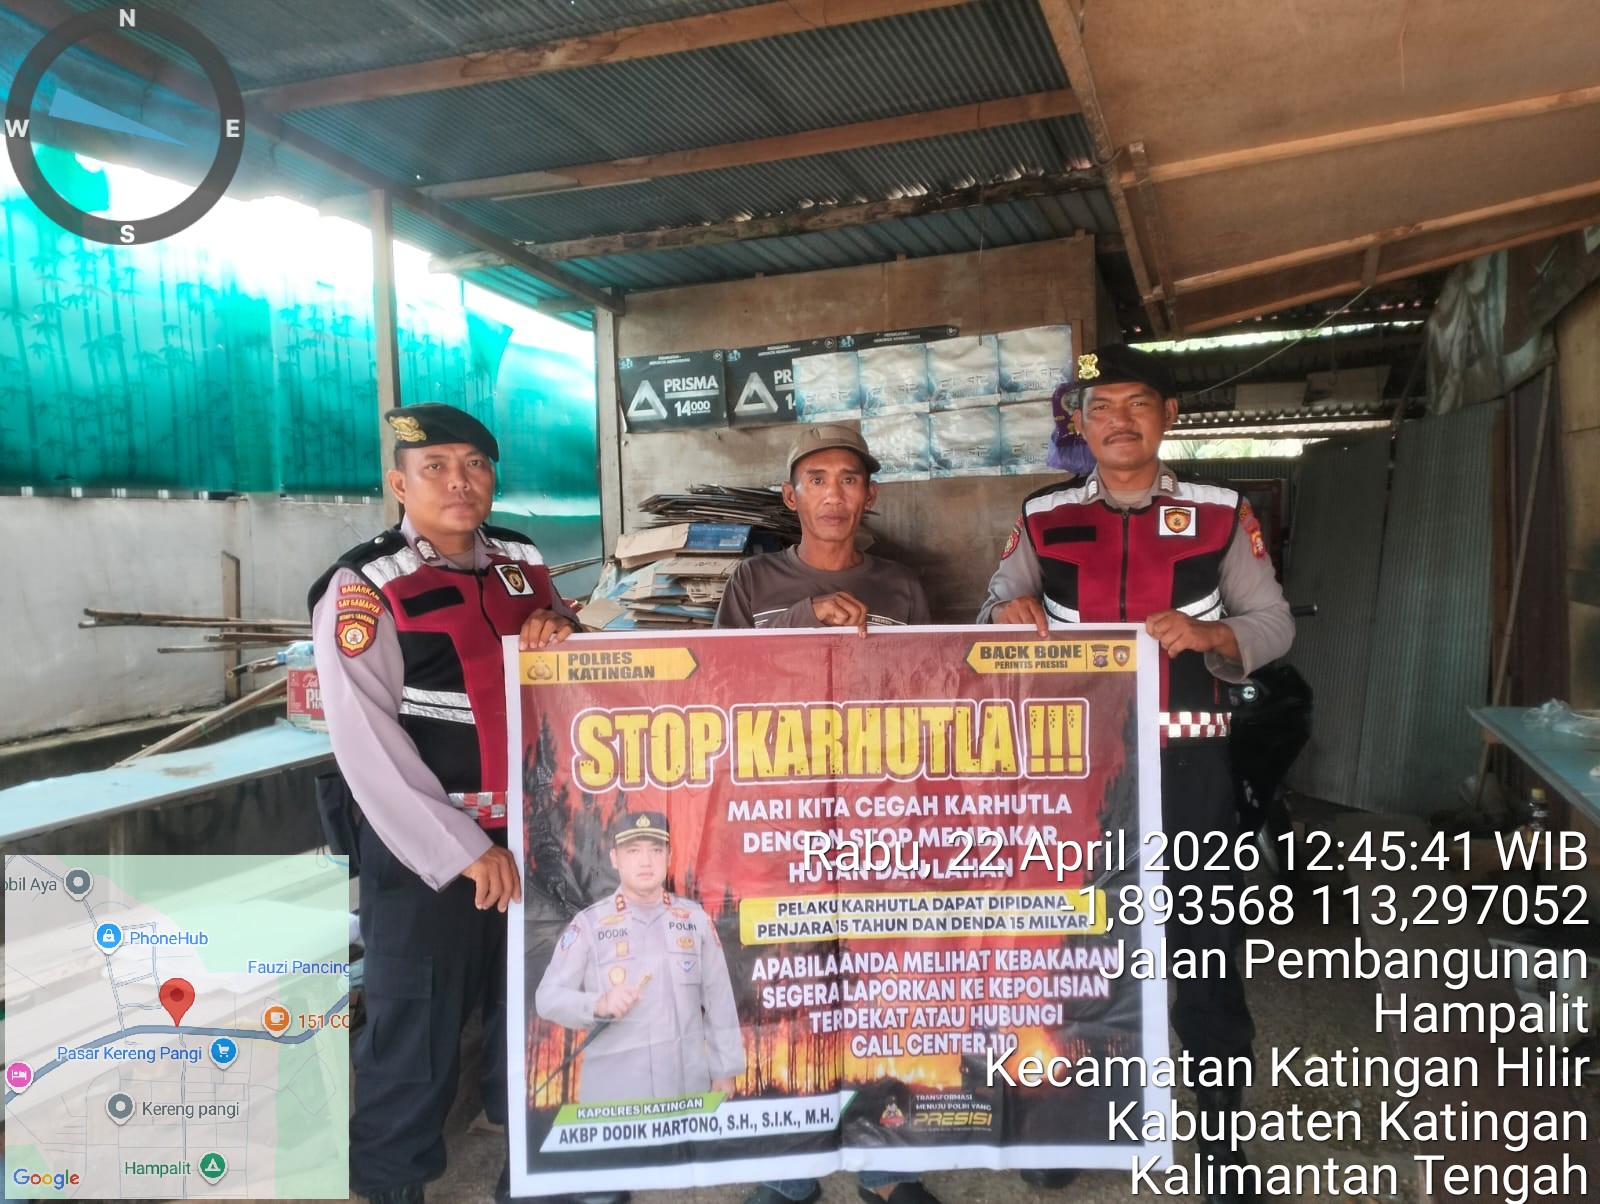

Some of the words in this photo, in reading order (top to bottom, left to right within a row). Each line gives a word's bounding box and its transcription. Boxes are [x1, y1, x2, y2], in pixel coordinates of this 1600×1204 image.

[663, 374, 719, 393] PRISMA
[674, 400, 711, 417] 14000
[567, 652, 633, 666] POLRES
[980, 645, 1029, 660] BACK
[1033, 644, 1082, 660] BONE
[567, 666, 656, 681] KATINGAN
[994, 660, 1033, 670] PERINTIS
[1035, 660, 1068, 670] PRESISI
[576, 707, 726, 789] STOP
[734, 704, 1018, 781] KARHUTLA
[1027, 702, 1085, 774] !!!
[728, 799, 792, 822] MARI
[799, 797, 850, 821] KITA
[854, 796, 938, 818] CEGAH
[944, 794, 1072, 816] KARHUTLA
[849, 827, 913, 849] STOP
[777, 901, 838, 917] PELAKU
[841, 898, 929, 914] KARHUTLA
[933, 897, 984, 912] DAPAT
[988, 895, 1069, 910] DIPIDANA
[598, 928, 629, 941] DODIK
[668, 921, 697, 932] POLRI
[757, 920, 834, 938] PENJARA
[852, 917, 908, 933] TAHUN
[912, 917, 948, 932] DAN
[951, 916, 1007, 931] DENDA
[1010, 916, 1025, 930] 15
[1029, 914, 1089, 929] MILYAR
[752, 953, 839, 981] APABILA
[839, 951, 900, 976] ANDA
[902, 949, 991, 974] MELIHAT
[995, 946, 1119, 972] KEBAKARAN
[762, 981, 840, 1009] SEGERA
[842, 977, 955, 1002] LAPORKAN
[960, 977, 985, 1000] KE
[988, 975, 1109, 999] KEPOLISIAN
[809, 1006, 909, 1034] TERDEKAT
[911, 1004, 966, 1029] ATAU
[970, 1003, 1063, 1027] HUBUNGI
[851, 1032, 904, 1057] CALL
[906, 1032, 987, 1056] CENTER
[990, 1031, 1018, 1055] 110
[915, 1093, 973, 1102] TRANSFORMASI
[915, 1103, 946, 1111] MENUJU
[971, 1103, 992, 1111] YANG
[577, 1104, 642, 1119] KAPOLRES
[643, 1098, 703, 1114] KATINGAN
[913, 1111, 993, 1126] PRESISI
[558, 1127, 598, 1145] AKBP
[602, 1122, 648, 1142] DODIK
[651, 1116, 723, 1139] HARTONO,
[726, 1113, 758, 1133] S.H.,
[762, 1110, 801, 1129] S.I.K.,
[804, 1107, 834, 1125] M.H.
